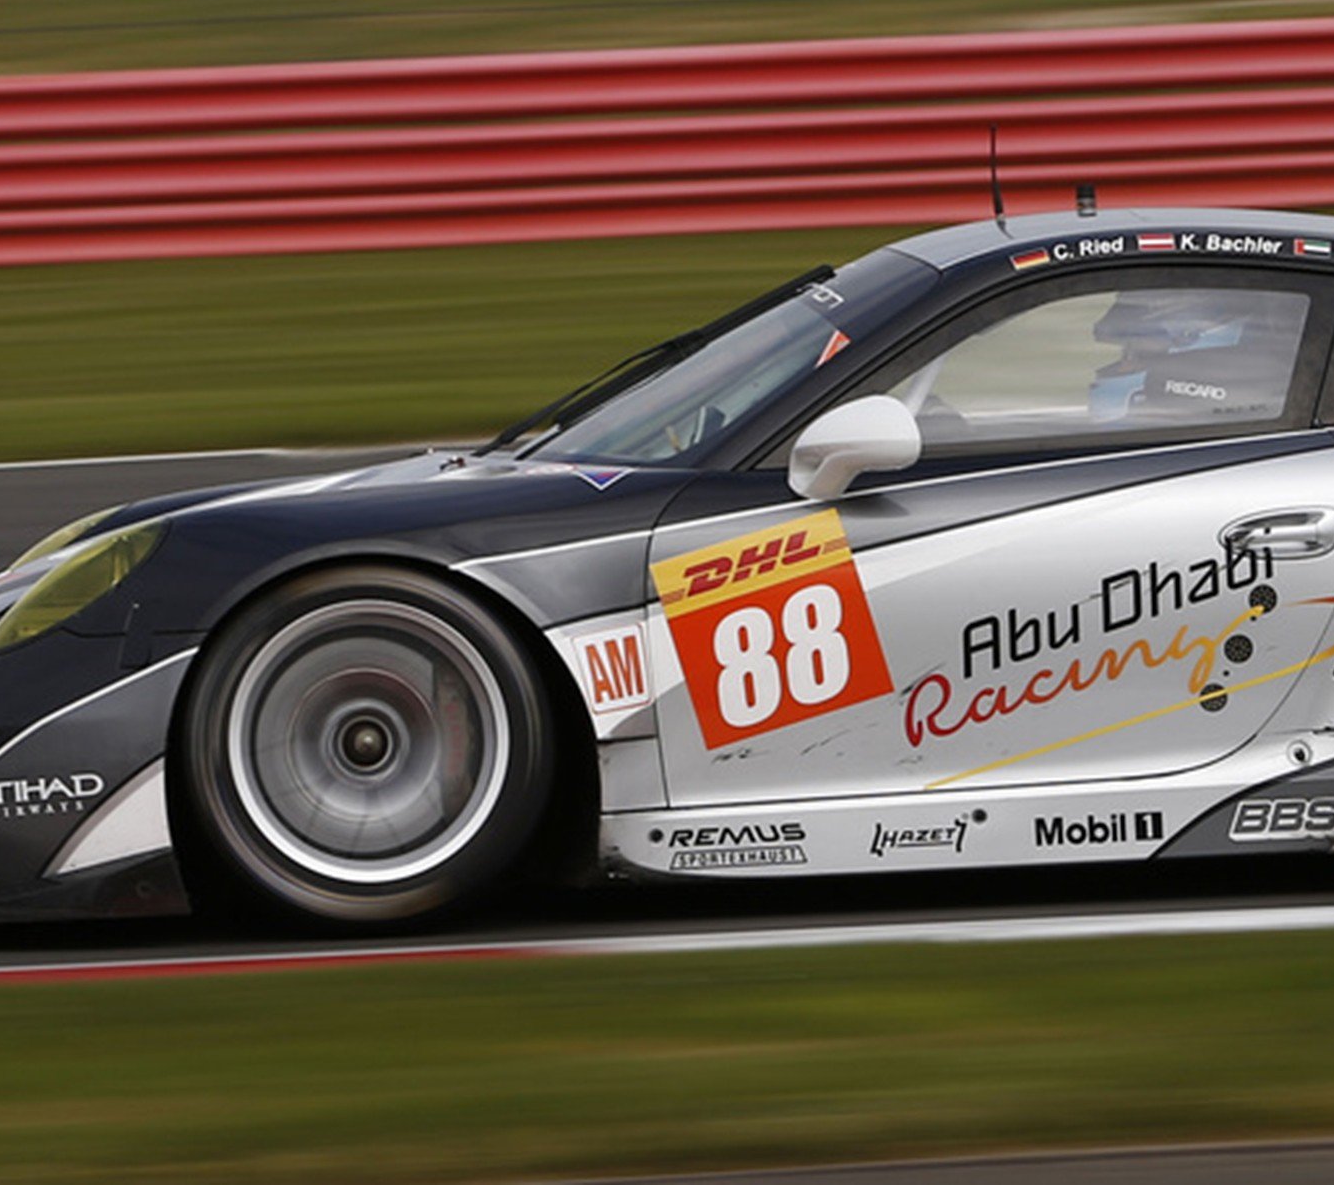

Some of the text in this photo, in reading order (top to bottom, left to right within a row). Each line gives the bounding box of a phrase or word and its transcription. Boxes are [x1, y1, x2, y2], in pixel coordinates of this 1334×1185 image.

[1053, 236, 1125, 261] C. Ried
[1180, 233, 1283, 255] K. Bachler
[683, 529, 822, 598] DHL
[962, 526, 1274, 680] Abu Dhabi
[584, 634, 645, 705] AM
[713, 583, 851, 729] 88
[903, 604, 1266, 749] Racing
[668, 822, 807, 848] REMUS
[1034, 813, 1127, 847] Mobil
